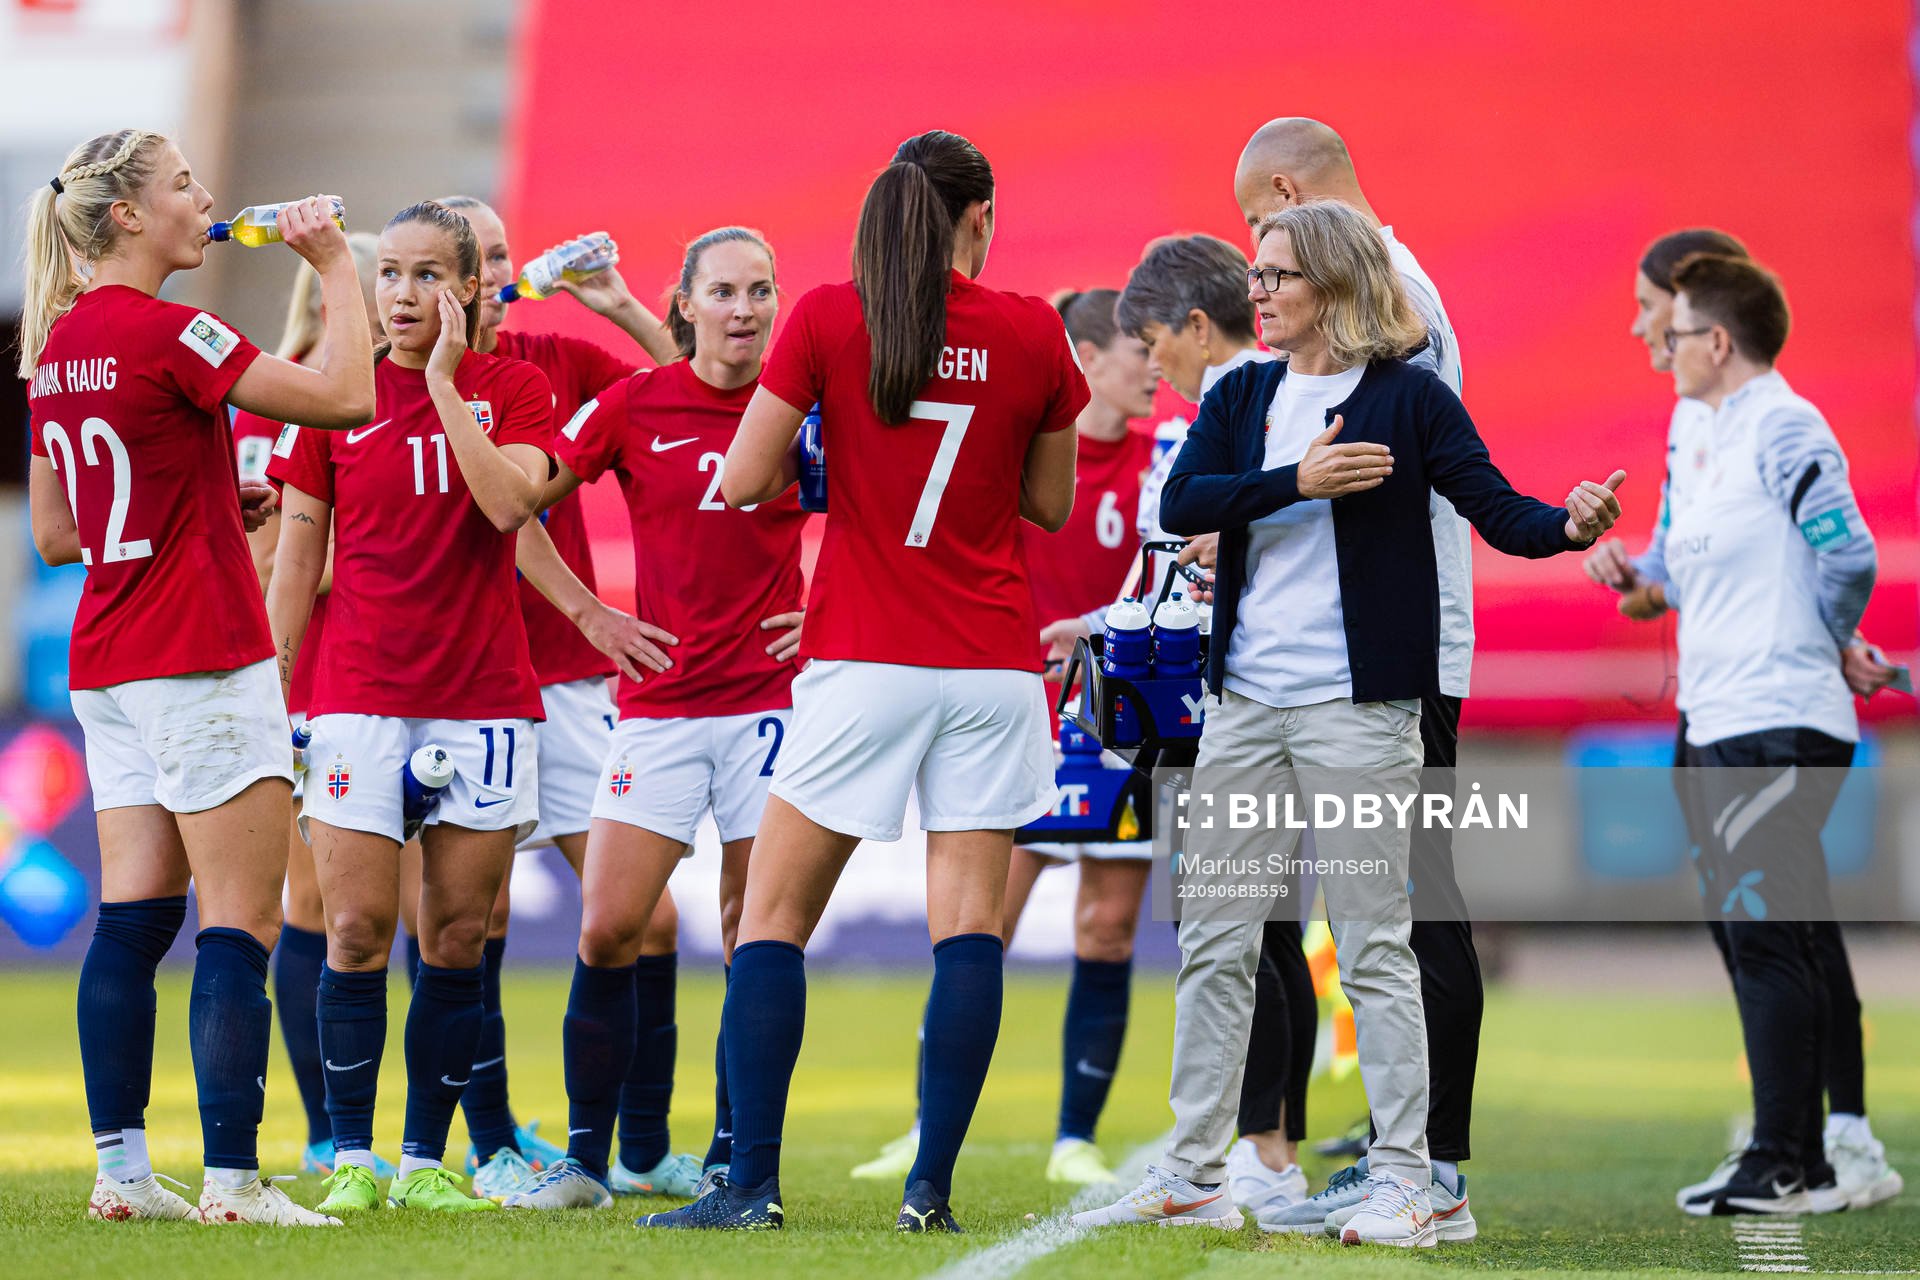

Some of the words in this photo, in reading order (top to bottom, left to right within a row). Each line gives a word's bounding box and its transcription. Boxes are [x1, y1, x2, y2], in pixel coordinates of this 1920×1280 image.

[66, 357, 117, 393] HAUG
[42, 416, 153, 566] 22
[406, 433, 449, 496] 11
[904, 401, 976, 547] 7
[1095, 491, 1124, 549] 6
[479, 727, 515, 788] 11
